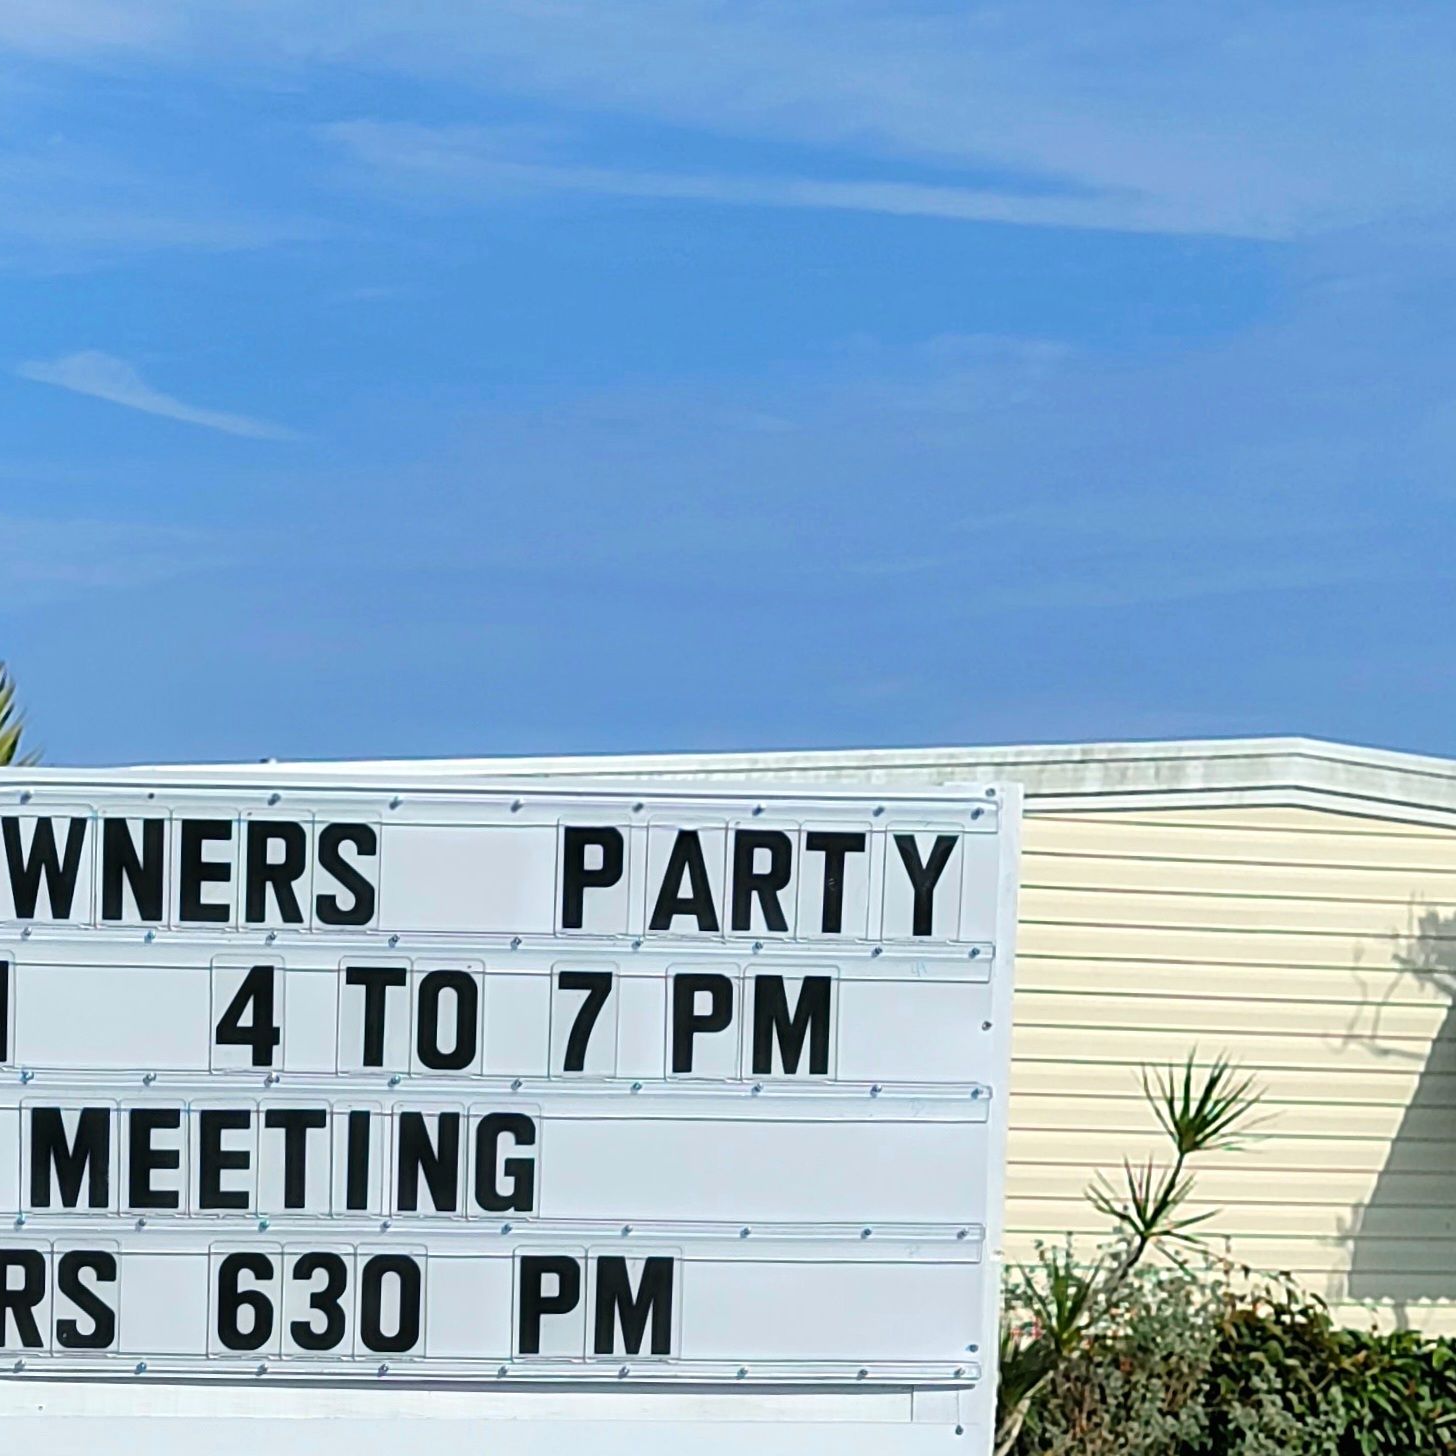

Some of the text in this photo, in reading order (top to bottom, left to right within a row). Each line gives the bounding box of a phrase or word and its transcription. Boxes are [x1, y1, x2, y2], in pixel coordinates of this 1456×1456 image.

[563, 827, 957, 936] PARTY
[216, 966, 280, 1066] 4
[346, 967, 477, 1070] TO
[559, 972, 612, 1071] 7
[673, 974, 831, 1074] PM
[31, 1108, 535, 1211] MEETING
[218, 1252, 420, 1352] 630
[519, 1256, 674, 1354] PM
